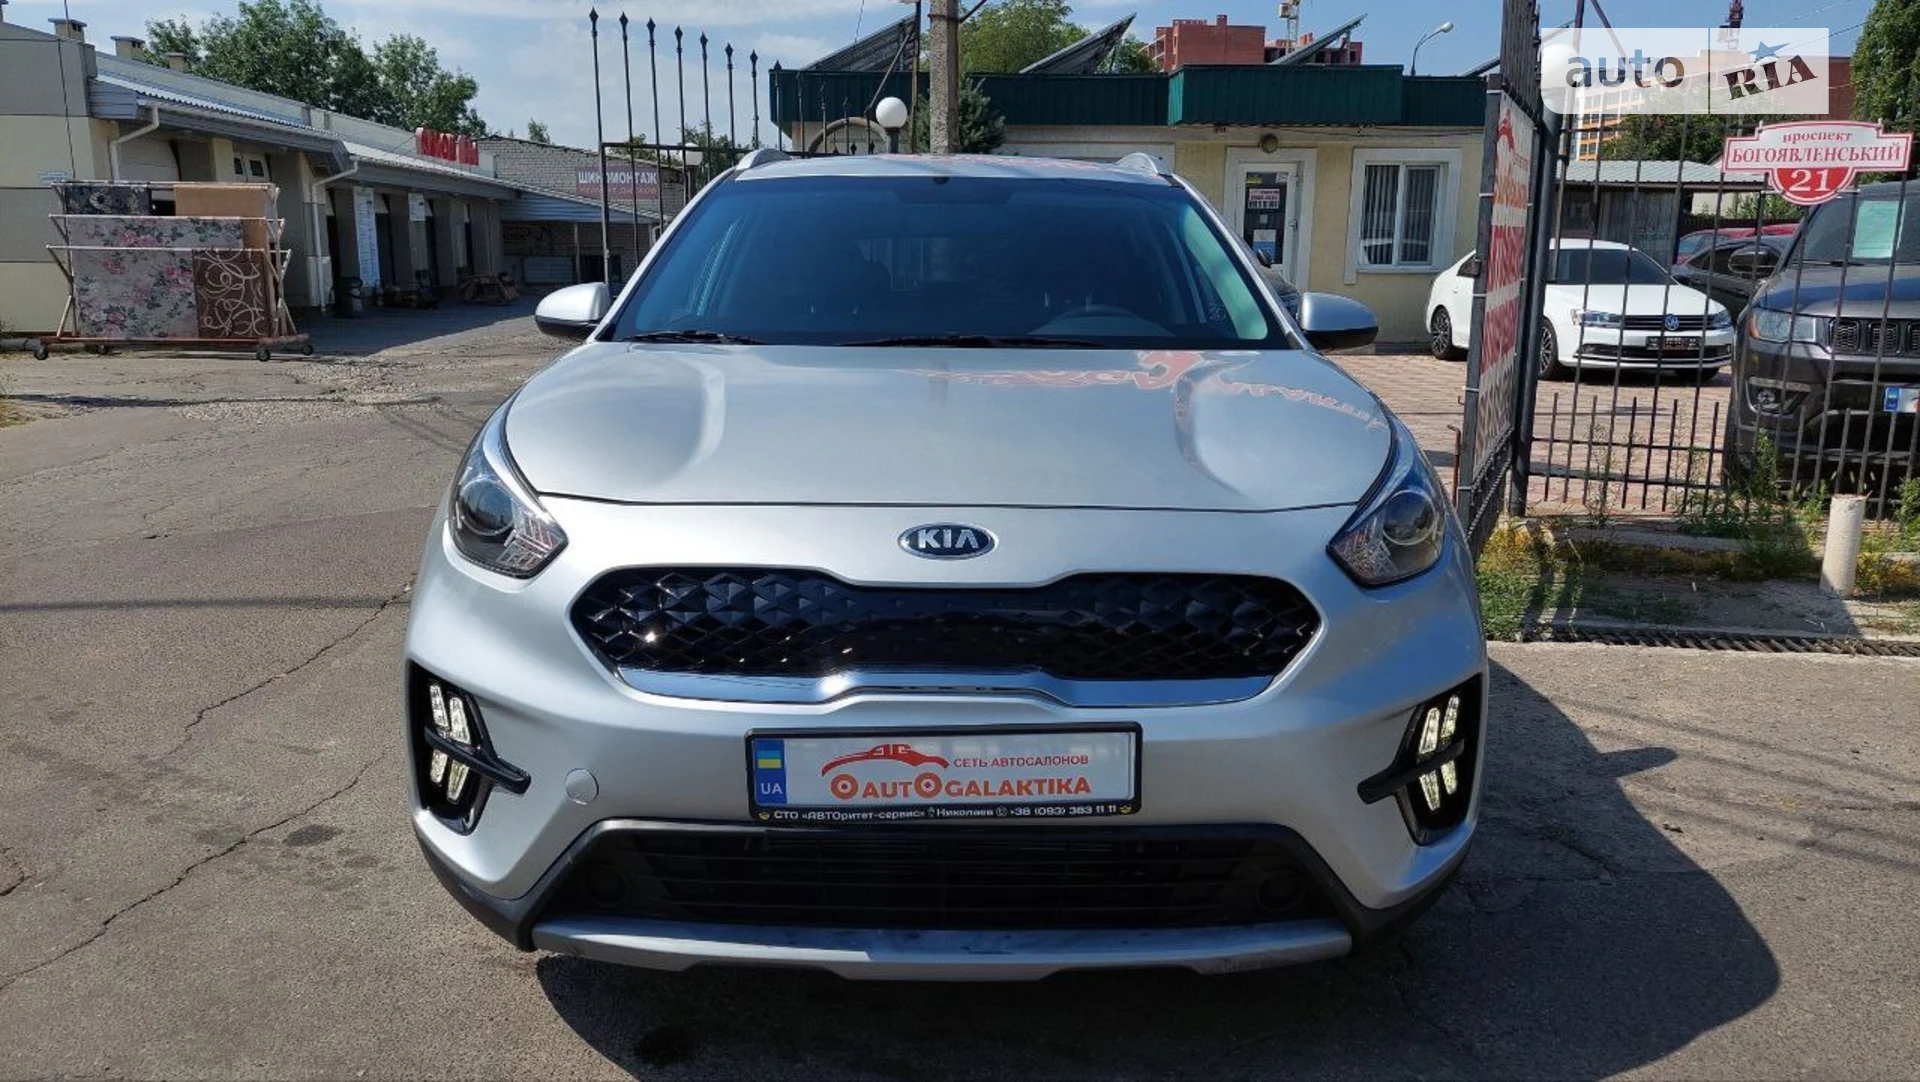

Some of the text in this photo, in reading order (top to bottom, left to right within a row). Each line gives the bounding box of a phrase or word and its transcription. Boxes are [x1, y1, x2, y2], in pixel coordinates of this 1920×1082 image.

[1783, 131, 1852, 144] проспект
[1732, 143, 1900, 163] БОГОЯВЛЕНСЬКИЙ
[1788, 169, 1831, 192] 21
[917, 529, 980, 549] KIA
[953, 755, 1089, 768] СЕТЬ АВТОСАЛОНОВ
[760, 782, 783, 794] UA
[774, 810, 799, 819] СТО
